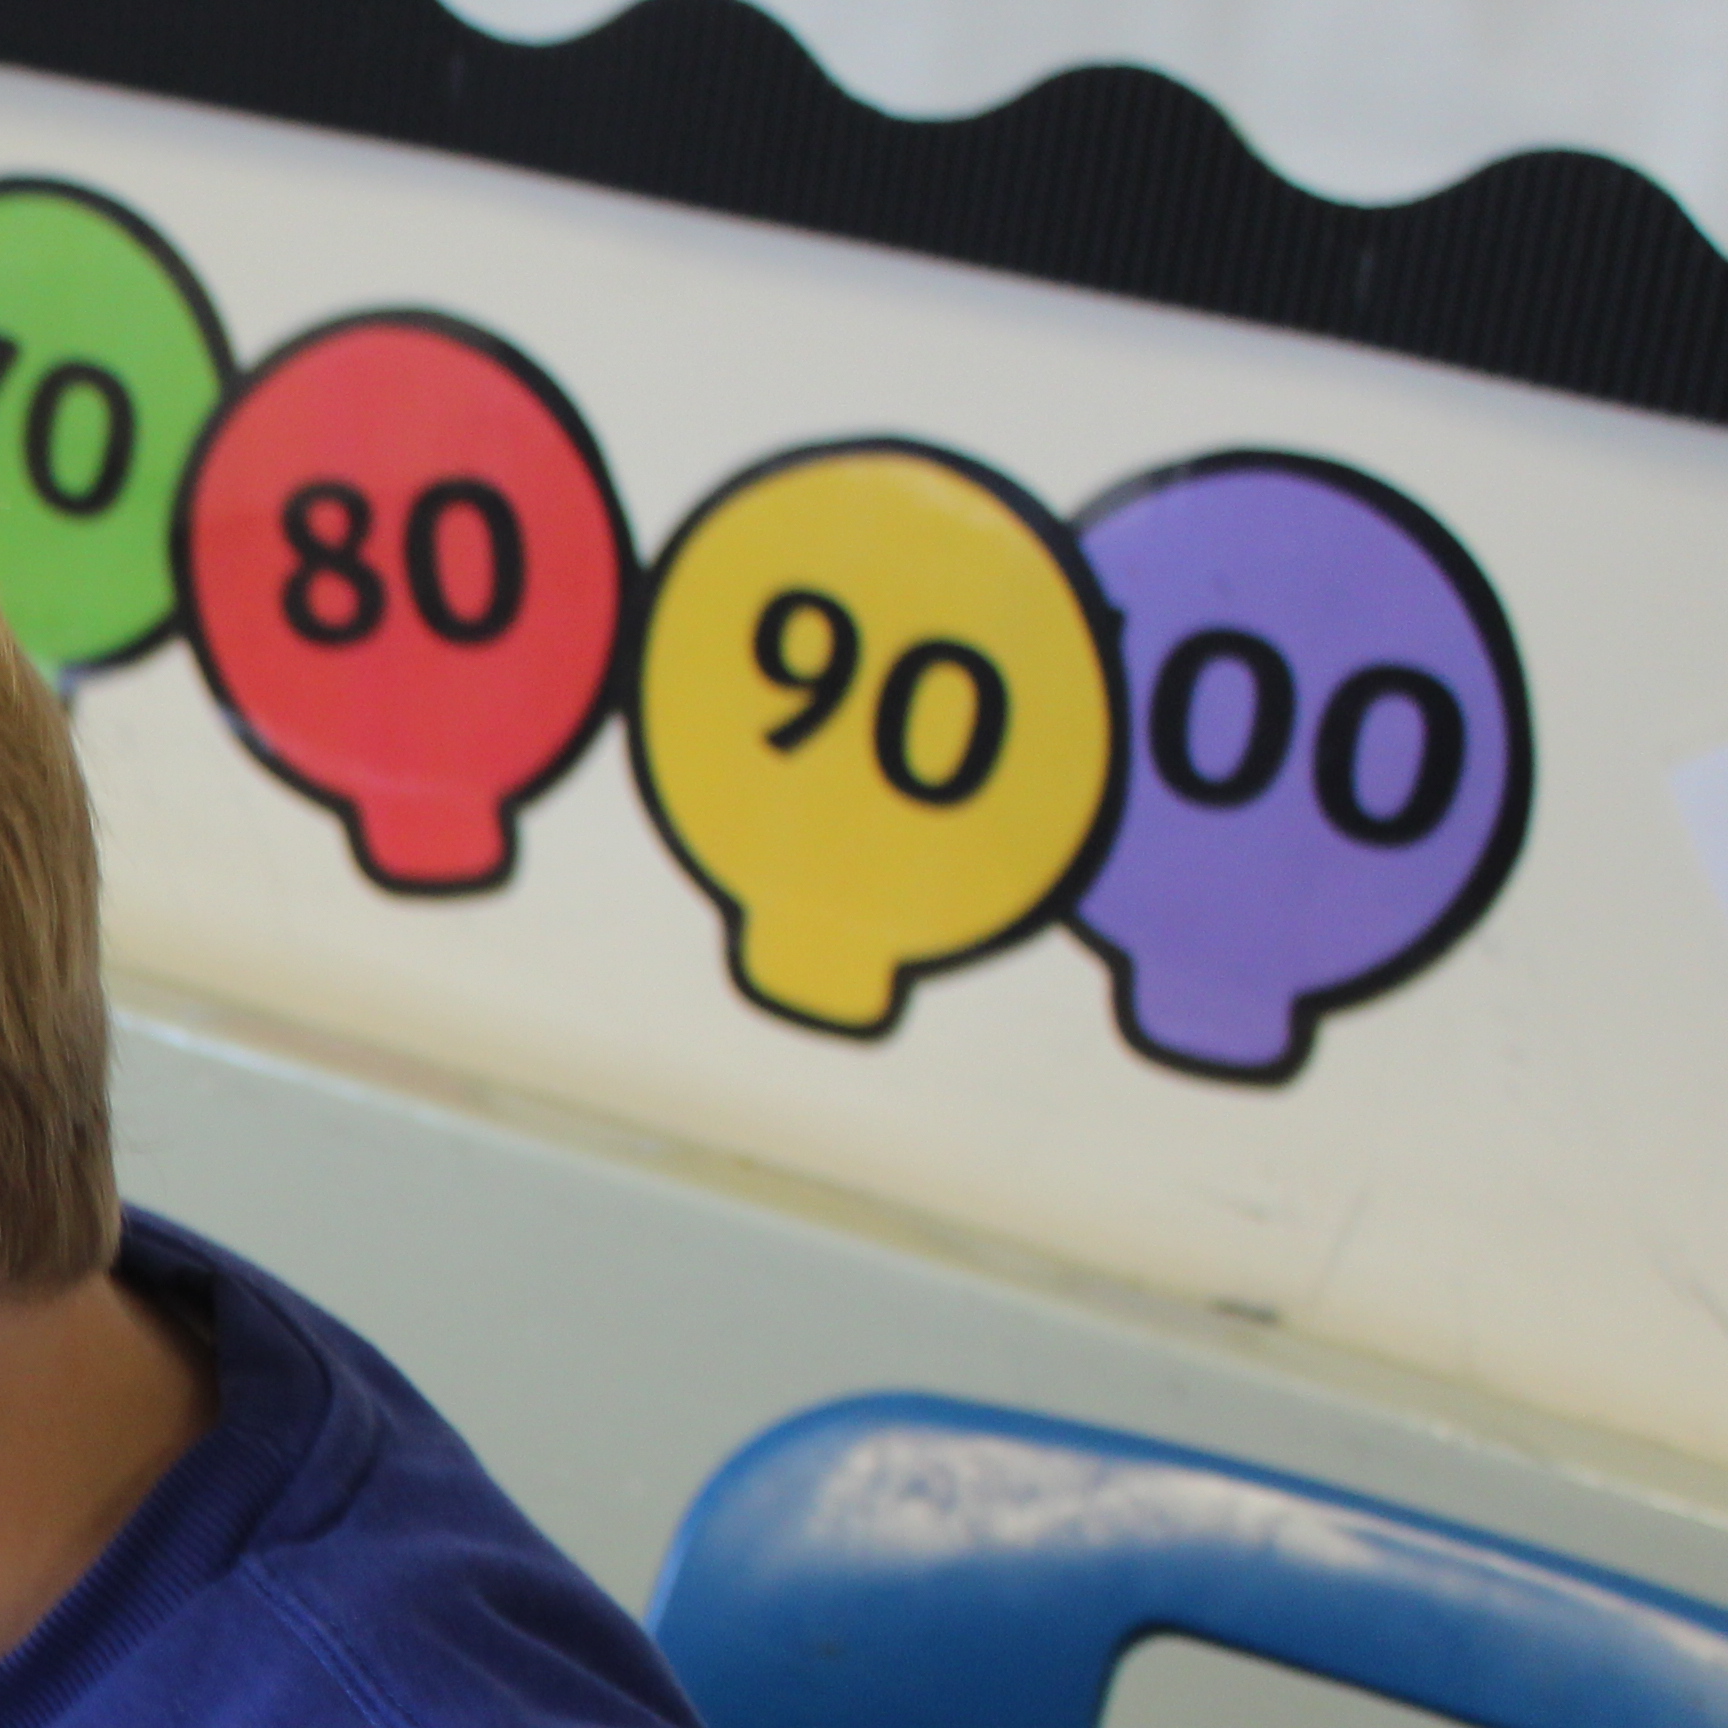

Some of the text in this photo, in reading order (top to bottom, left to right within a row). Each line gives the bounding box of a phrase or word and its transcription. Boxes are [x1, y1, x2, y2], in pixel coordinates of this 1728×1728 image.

[280, 477, 527, 647] 80
[752, 587, 1011, 808] 90
[1146, 627, 1468, 850] 00
